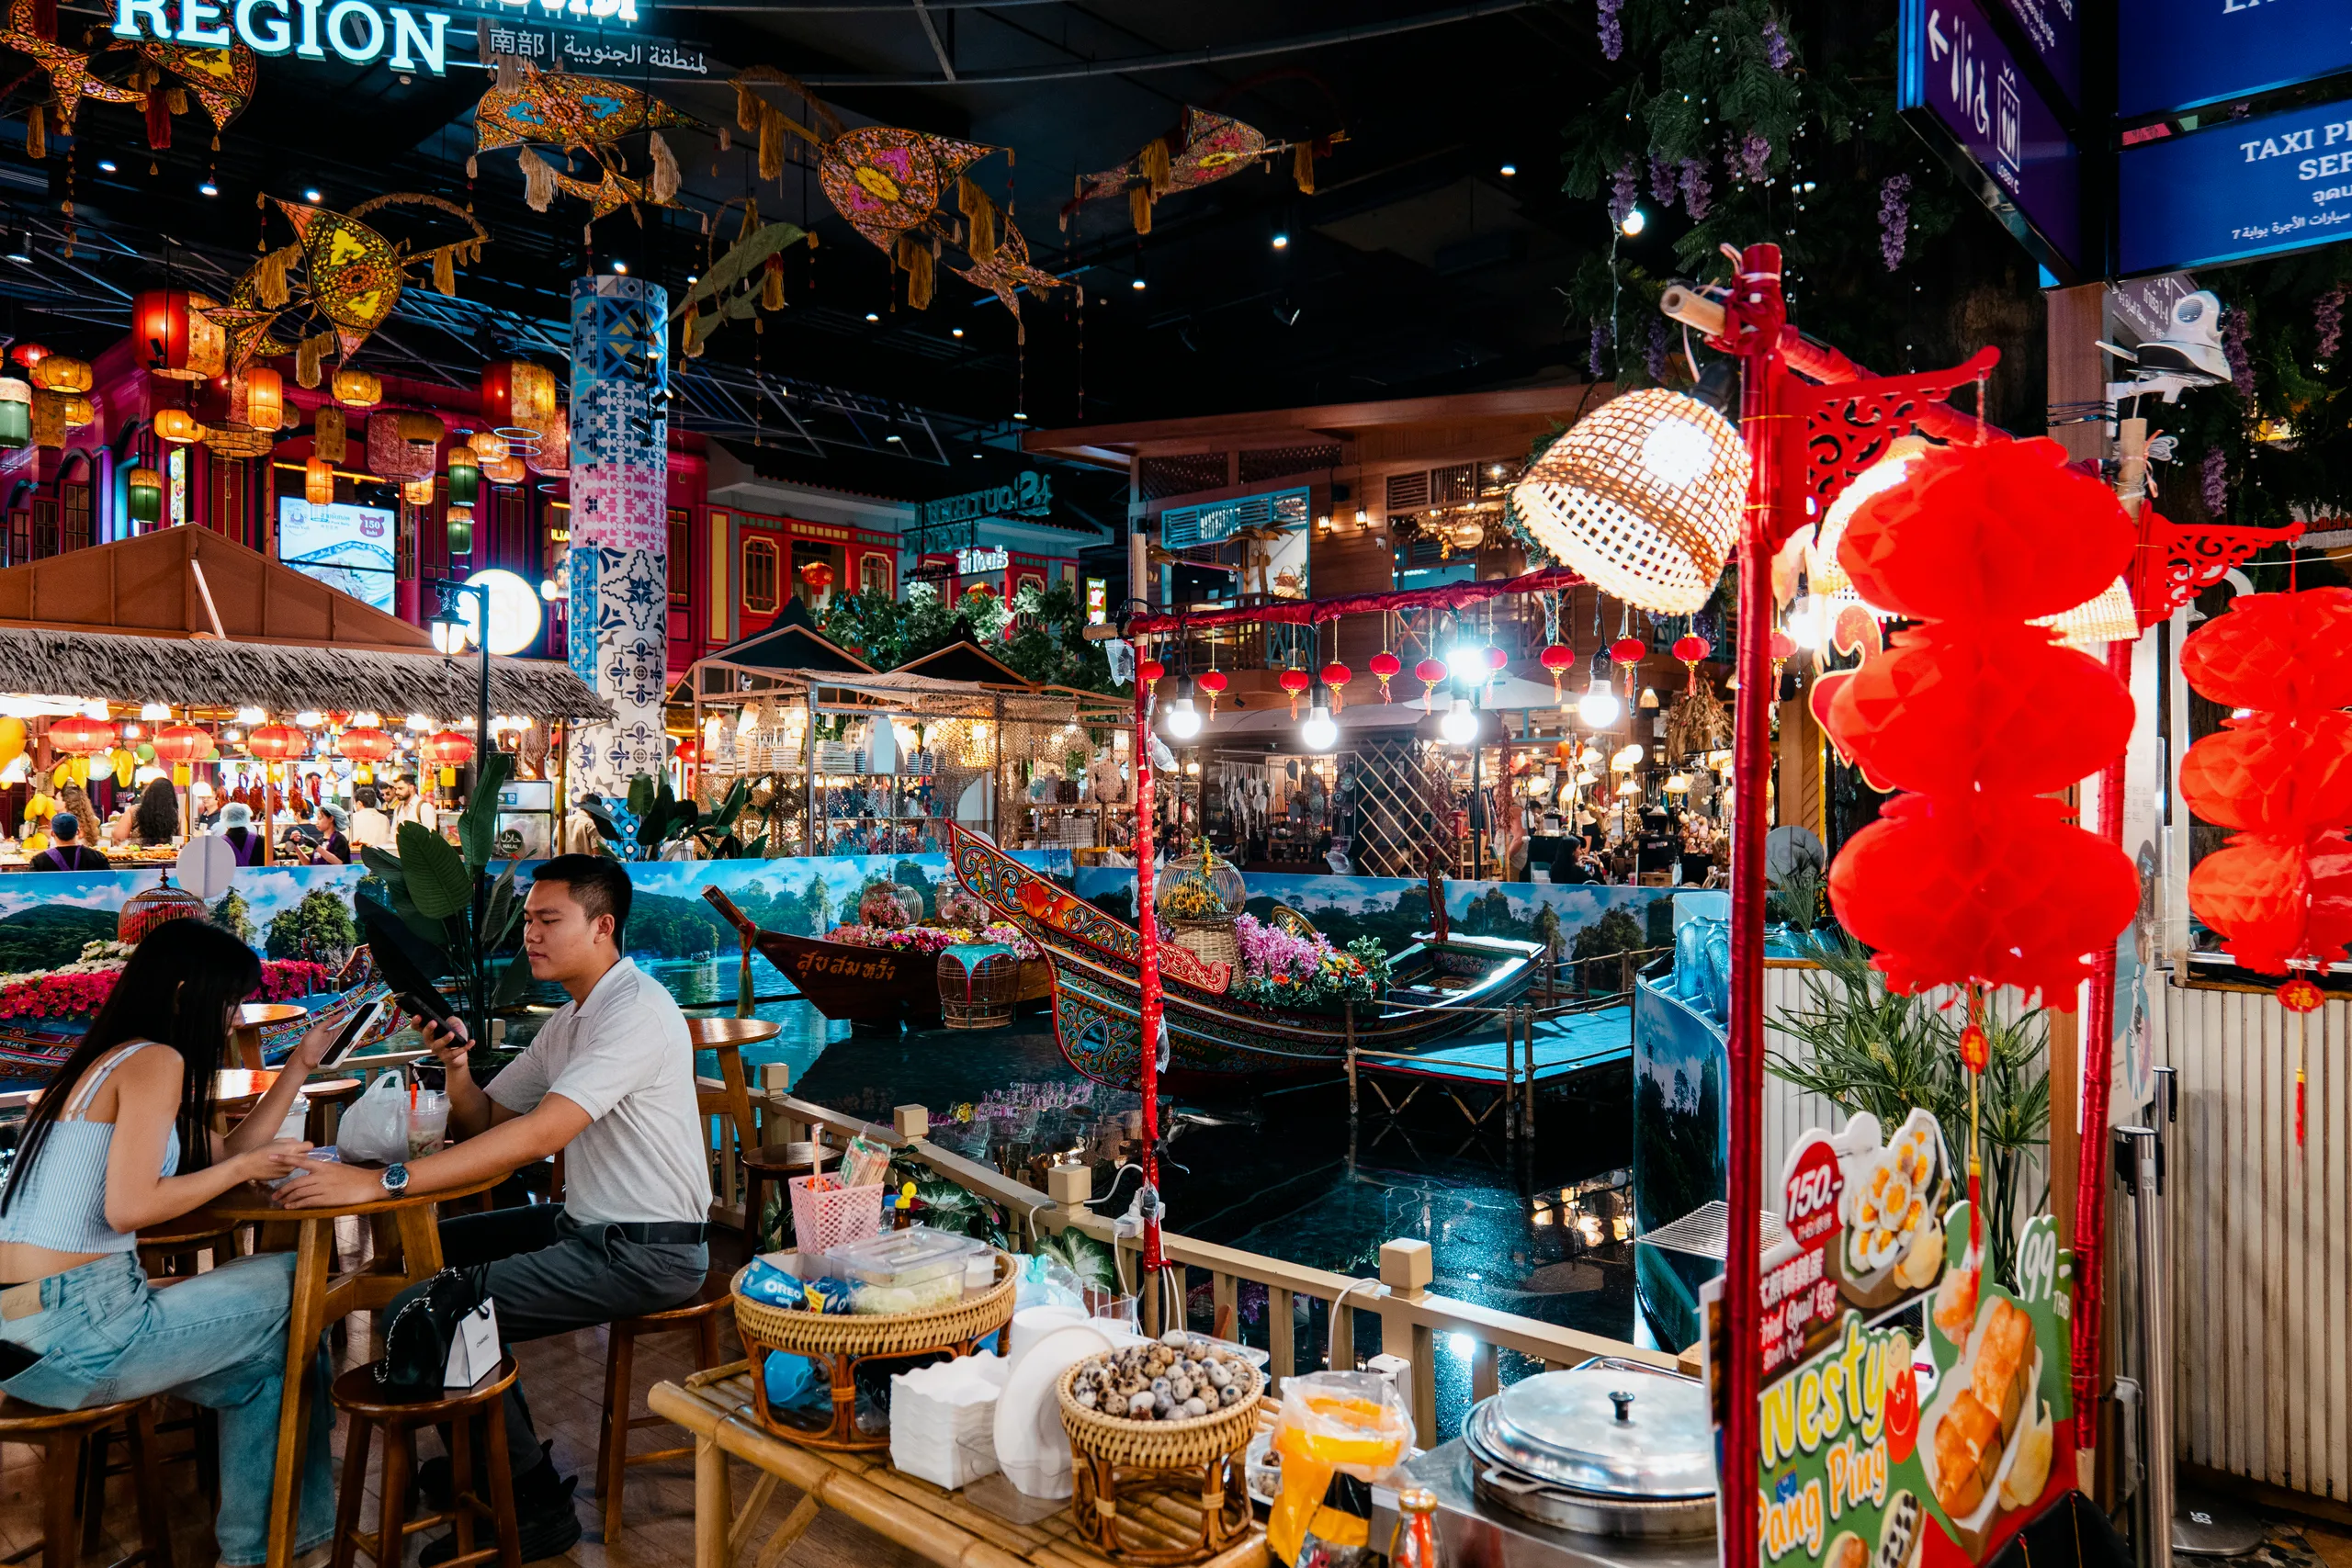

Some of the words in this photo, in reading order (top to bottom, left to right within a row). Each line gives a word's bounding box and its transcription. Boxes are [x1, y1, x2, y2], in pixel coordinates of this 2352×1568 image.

[112, 0, 451, 75] REGION
[490, 28, 545, 58] 南部
[563, 34, 641, 68] الجنوبية
[2239, 129, 2315, 163] TAXI
[2232, 229, 2242, 240] 7
[364, 519, 380, 530] 150
[500, 831, 522, 843] حلال
[764, 1279, 803, 1300] OREO
[1816, 1280, 1838, 1319] Egg
[1759, 1316, 1889, 1469] Nesty
[1826, 1433, 1889, 1520] Ping
